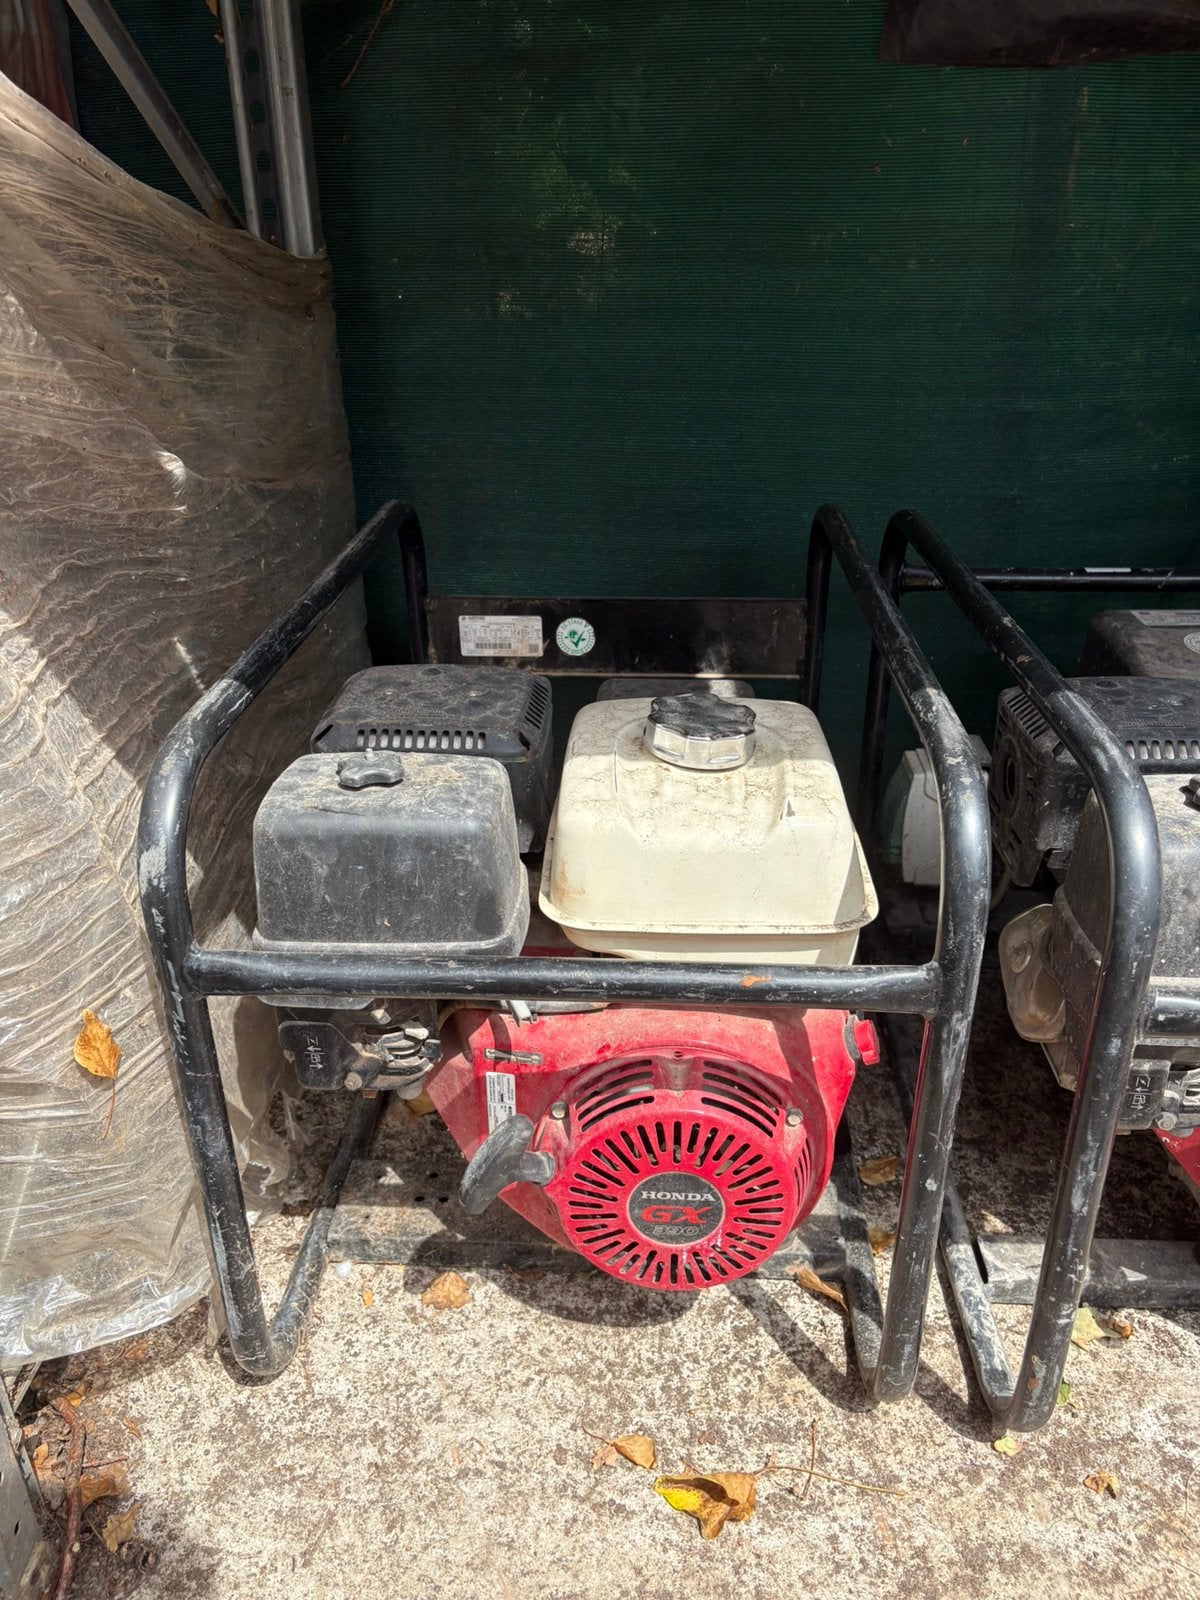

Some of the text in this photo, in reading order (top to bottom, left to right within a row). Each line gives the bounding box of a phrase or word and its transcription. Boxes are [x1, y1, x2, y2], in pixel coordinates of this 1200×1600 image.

[641, 1191, 716, 1201] HONDA
[641, 1205, 713, 1224] GX
[652, 1225, 699, 1236] 390
